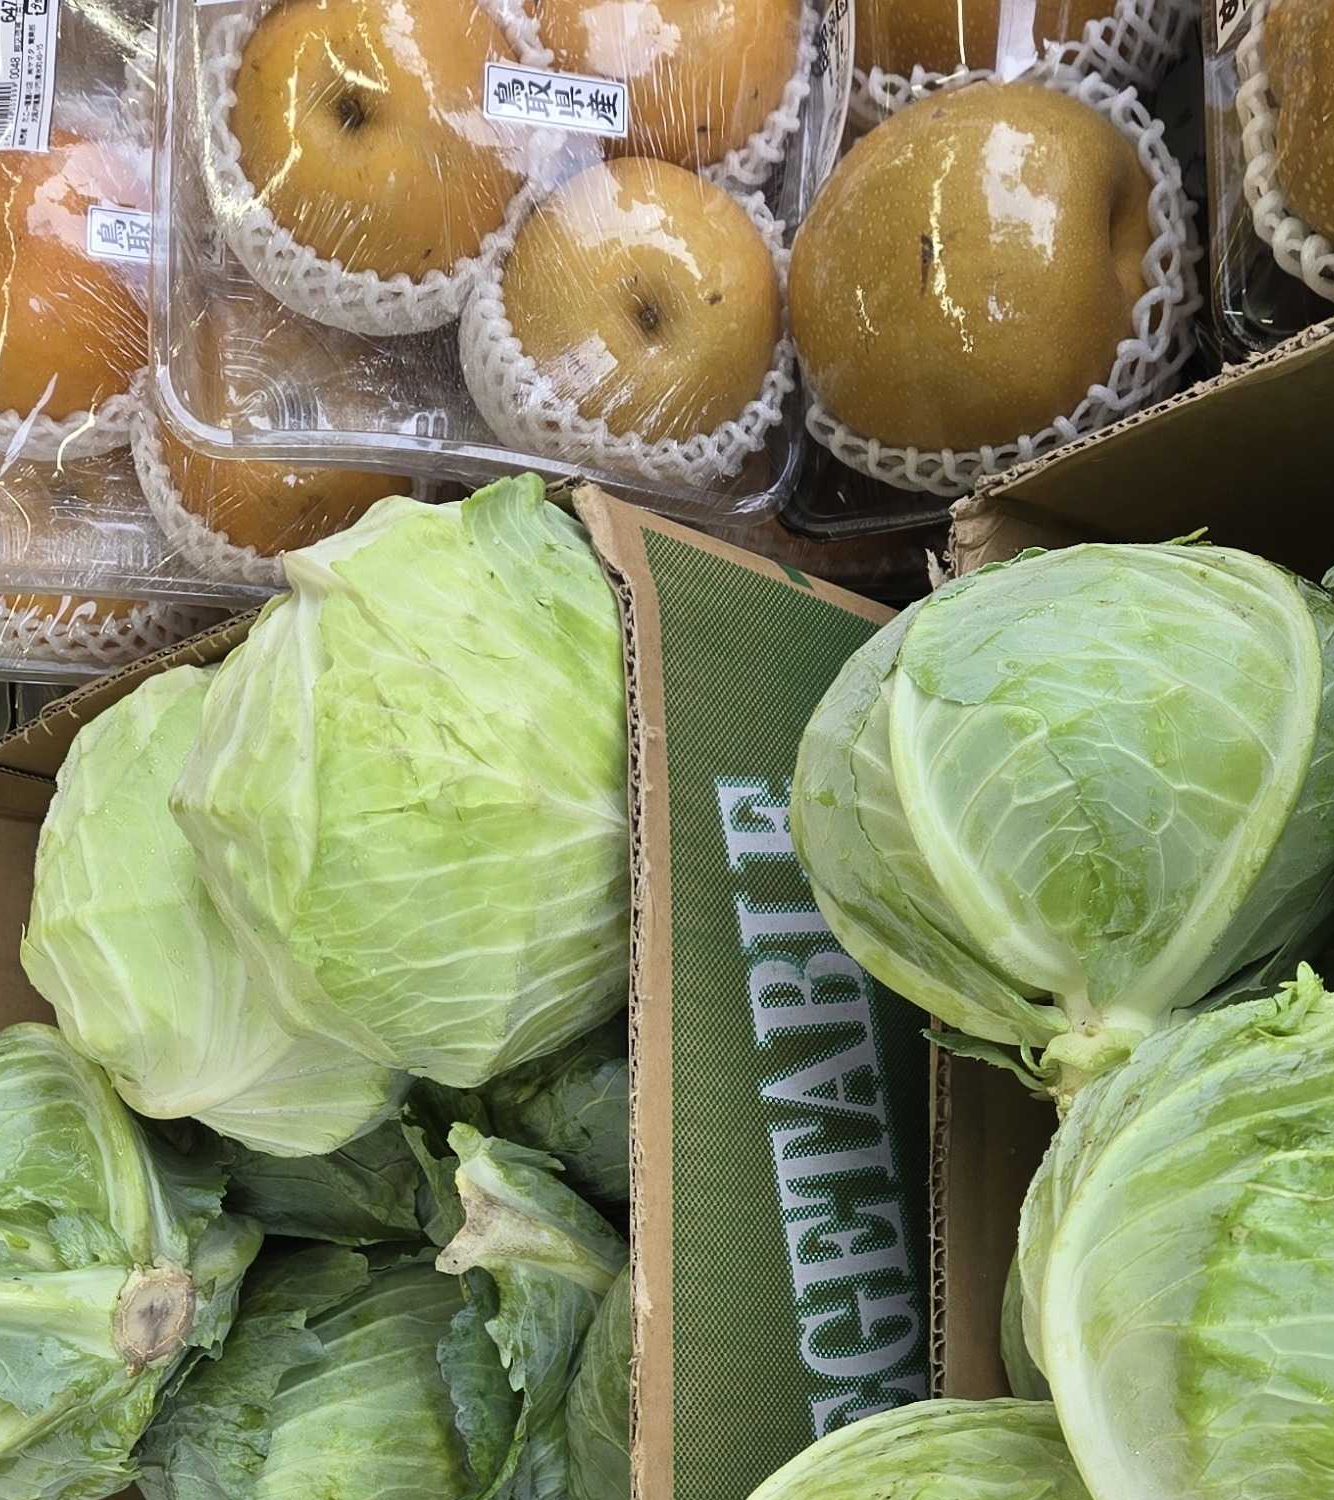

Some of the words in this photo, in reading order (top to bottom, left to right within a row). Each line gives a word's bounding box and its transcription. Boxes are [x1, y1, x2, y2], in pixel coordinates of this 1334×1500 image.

[0, 0, 17, 23] 647
[493, 76, 619, 127] 鳥取県産
[97, 218, 151, 254] 鳥取
